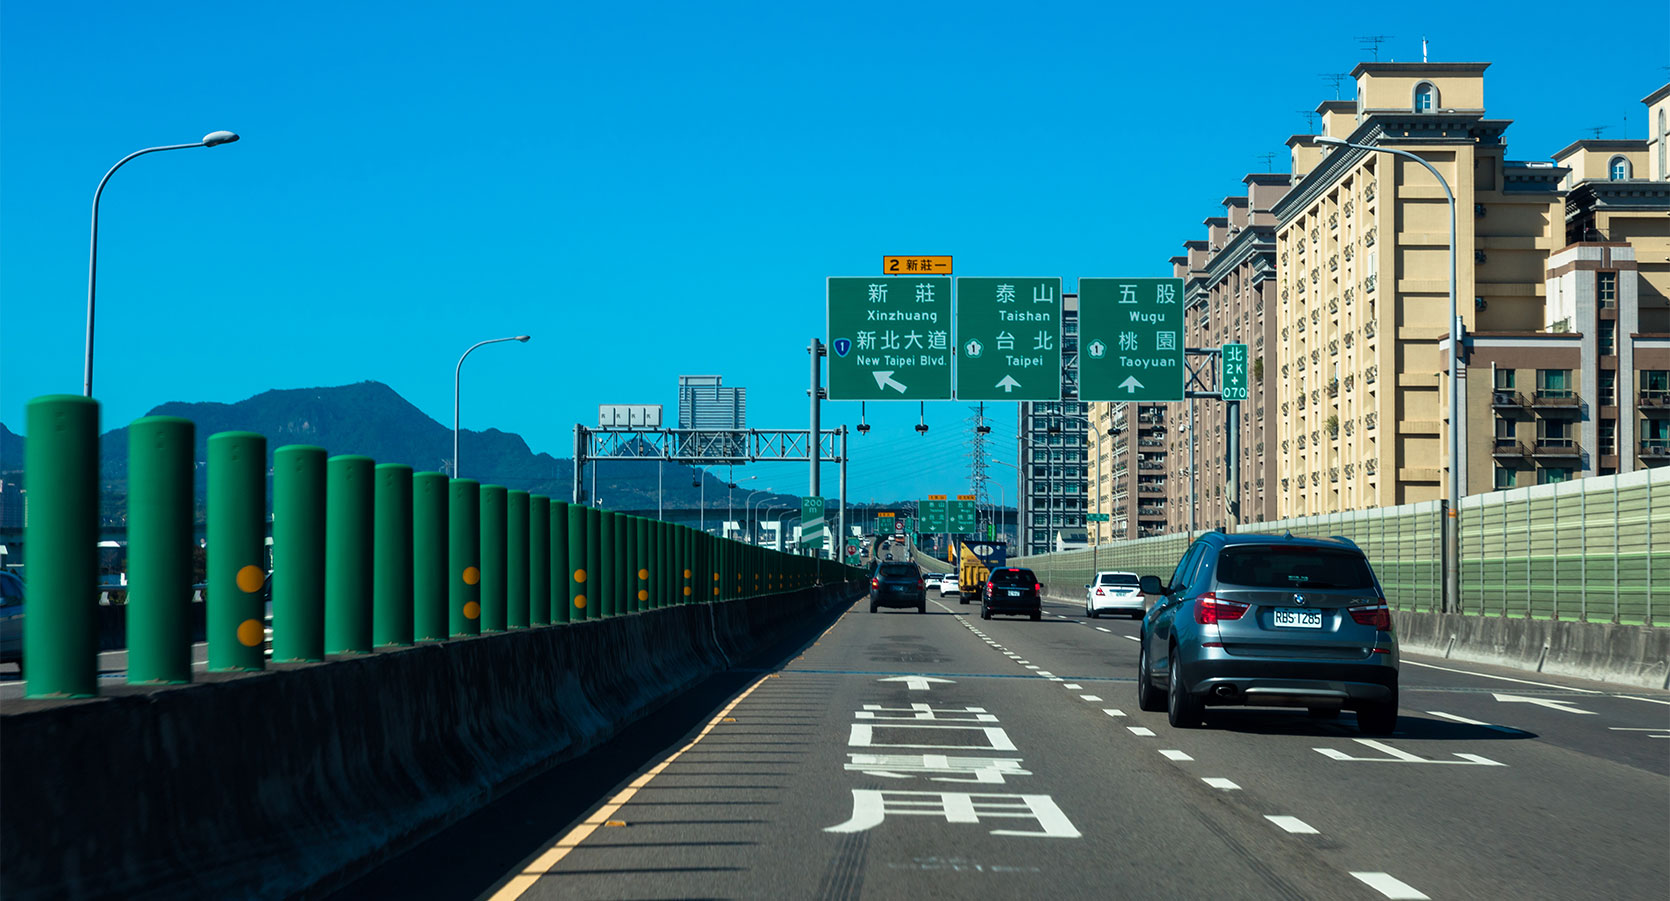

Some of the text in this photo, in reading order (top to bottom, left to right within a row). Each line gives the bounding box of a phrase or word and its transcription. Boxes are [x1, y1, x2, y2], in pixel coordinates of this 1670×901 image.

[890, 259, 946, 271] 2 新莊一
[868, 283, 935, 303] 新莊
[996, 283, 1053, 303] 泰山
[1118, 284, 1176, 304] 五股
[867, 310, 937, 323] Xinzhuang
[999, 310, 1050, 321] Taishan
[1129, 311, 1165, 325] Wugu
[857, 330, 947, 350] 新北大道
[996, 331, 1053, 350] 台北
[1118, 331, 1176, 351] 桃園
[1228, 347, 1242, 361] 北
[857, 355, 947, 368] New Taipei Blvd.
[1005, 355, 1043, 368] Taipei
[1119, 356, 1176, 369] Taoyuan
[1226, 364, 1243, 374] 2K
[1223, 387, 1246, 398] 070
[804, 499, 822, 507] 200
